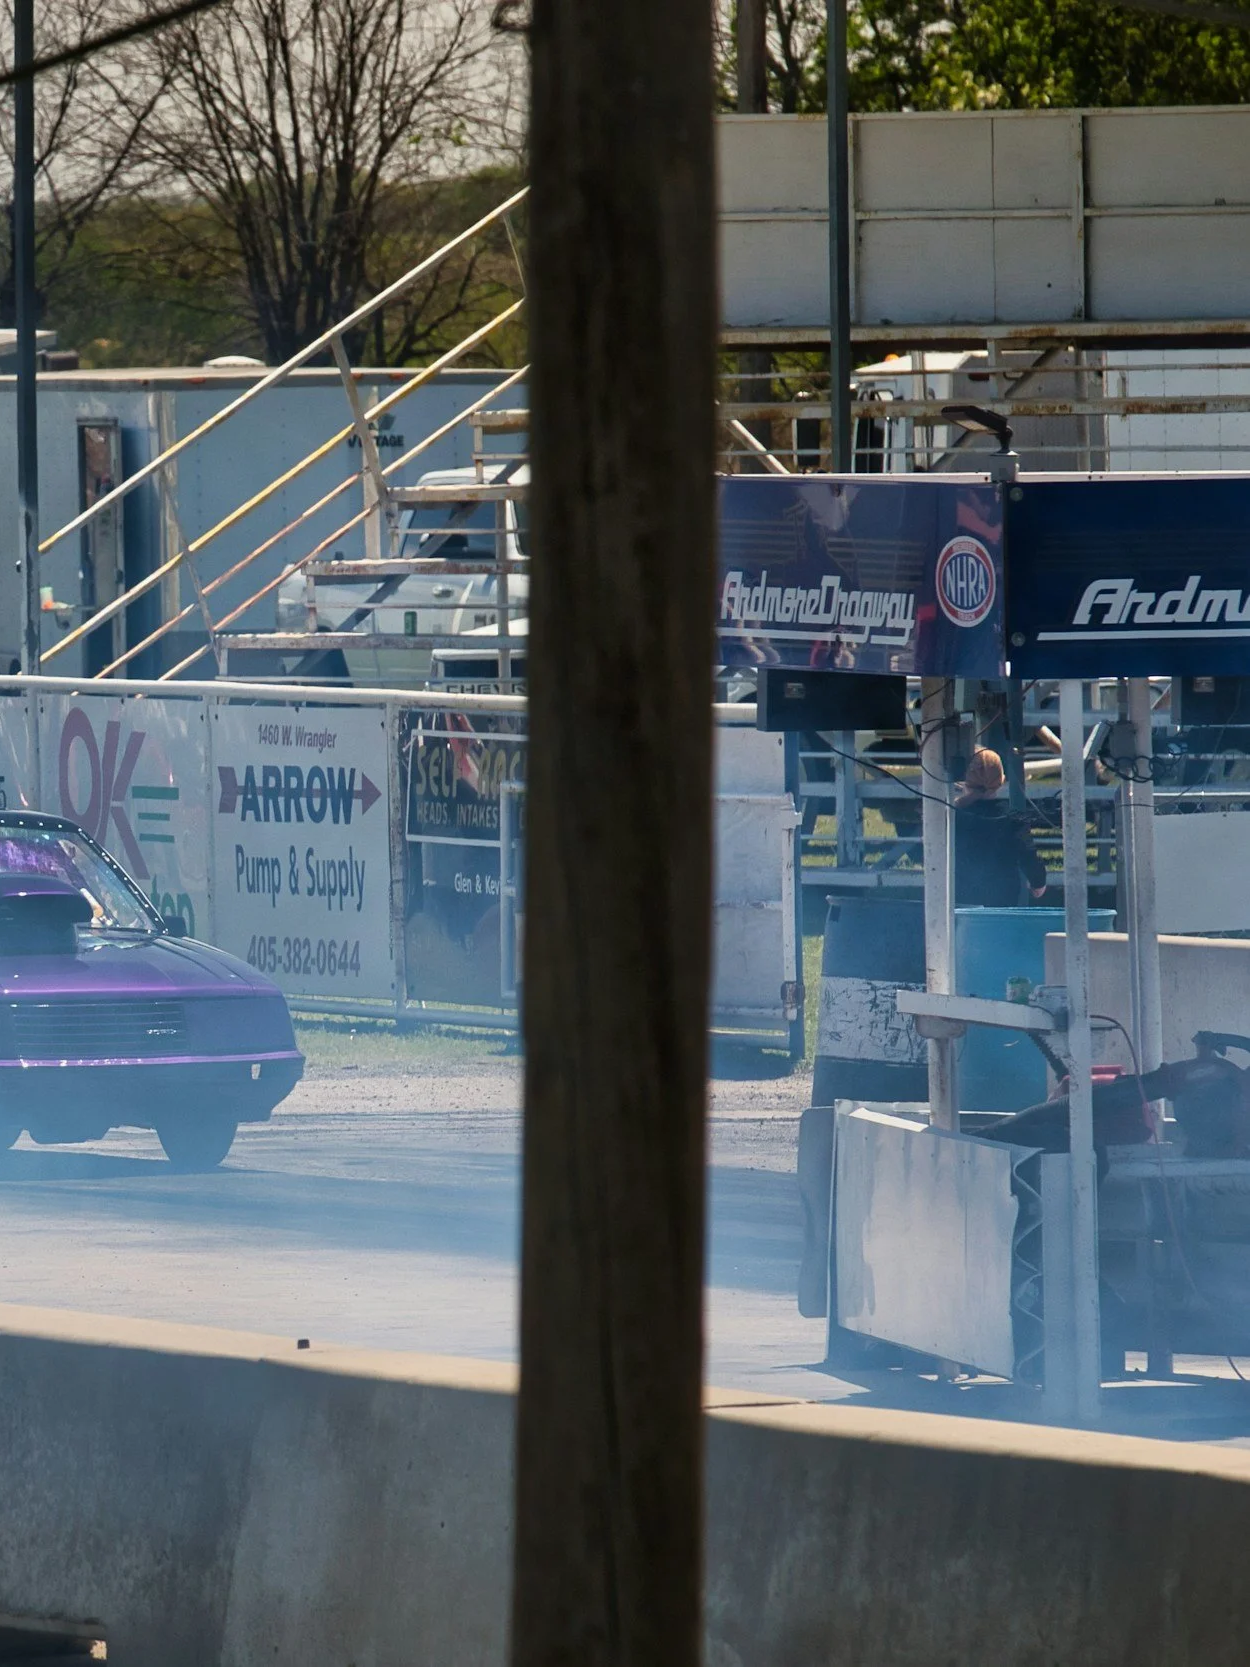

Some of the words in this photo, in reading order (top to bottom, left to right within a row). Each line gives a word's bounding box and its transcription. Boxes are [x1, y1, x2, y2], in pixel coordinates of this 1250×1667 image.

[347, 434, 404, 448] VITAGE
[945, 555, 987, 608] NHRA
[1072, 575, 1250, 625] Ardm
[258, 724, 279, 745] 1460
[282, 725, 292, 746] W.
[295, 726, 337, 753] Wrangler
[58, 707, 151, 880] OK
[241, 765, 356, 825] ARROW
[415, 745, 462, 798] SELF
[457, 804, 499, 828] INTAKES
[235, 844, 281, 908] Pump
[289, 845, 299, 896] &
[305, 845, 365, 912] Supply
[454, 872, 472, 893] Glen
[475, 874, 482, 894] &
[485, 875, 500, 895] Kev
[247, 934, 361, 977] 405-382-0644
